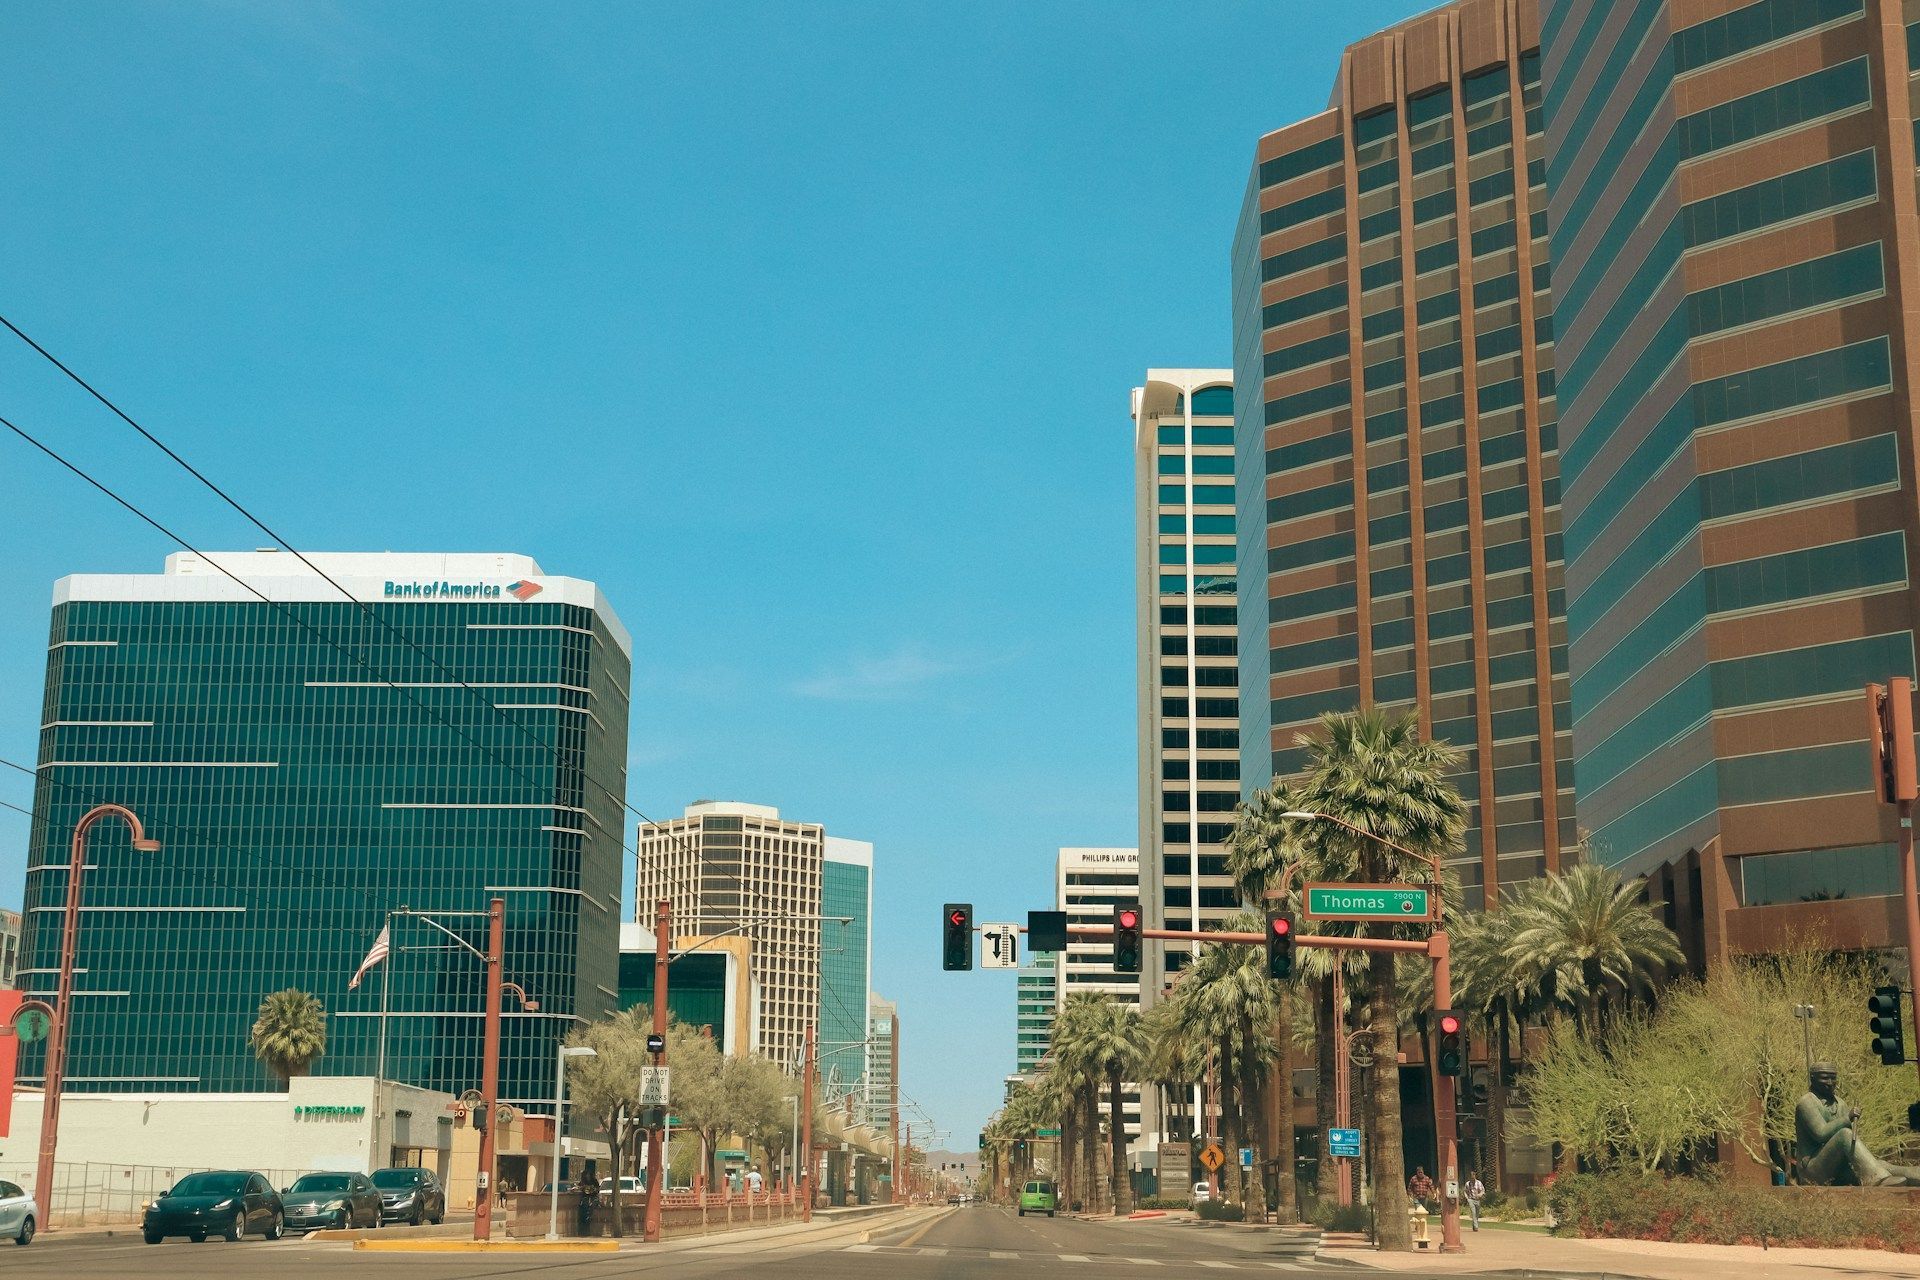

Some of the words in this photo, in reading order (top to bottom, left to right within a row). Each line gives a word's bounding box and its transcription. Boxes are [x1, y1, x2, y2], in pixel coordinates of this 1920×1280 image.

[384, 581, 421, 597] Bank
[423, 581, 439, 597] of
[440, 581, 500, 598] America
[1082, 854, 1110, 862] PHILLIPS
[1112, 854, 1126, 862] LAW
[1322, 895, 1385, 909] Thomas
[304, 1106, 366, 1117] DISPENSARY
